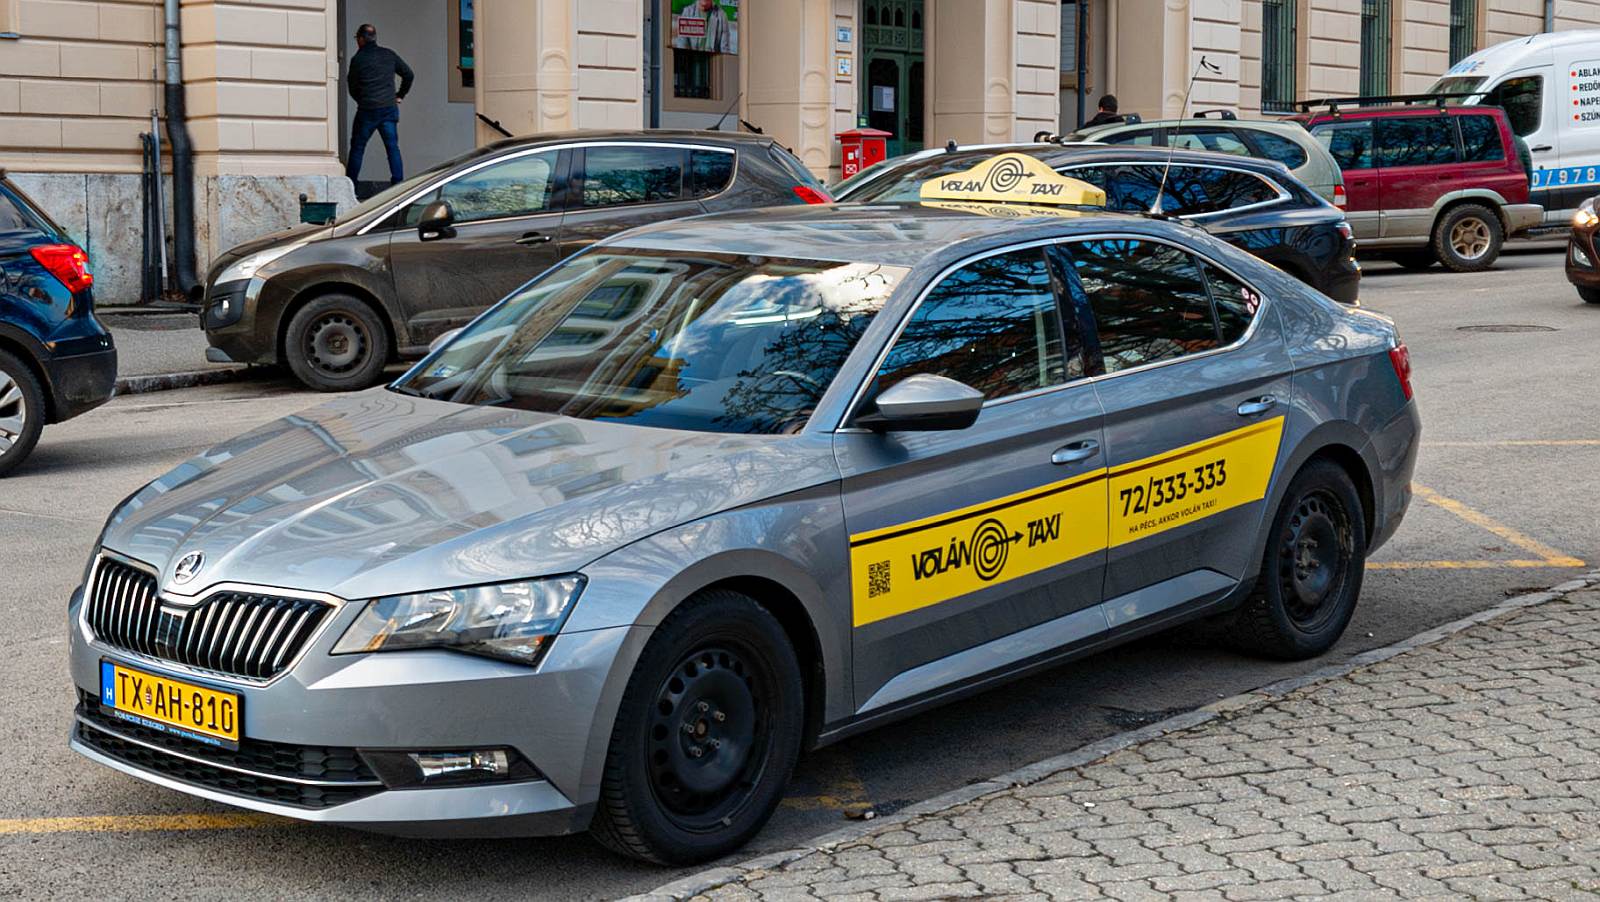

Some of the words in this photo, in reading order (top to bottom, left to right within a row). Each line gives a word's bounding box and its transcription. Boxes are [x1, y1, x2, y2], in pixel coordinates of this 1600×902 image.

[940, 179, 985, 192] VOLÁN
[1030, 183, 1064, 196] TAXI
[1120, 459, 1227, 517] 72/333-333
[1128, 524, 1138, 534] HA
[1159, 511, 1180, 525] AKKOR
[1181, 503, 1201, 517] VOLÁN
[911, 537, 971, 581] VOLÁN
[1027, 513, 1062, 548] TAXI
[105, 687, 113, 700] H
[118, 671, 144, 711] TX
[155, 682, 233, 734] AH-810
